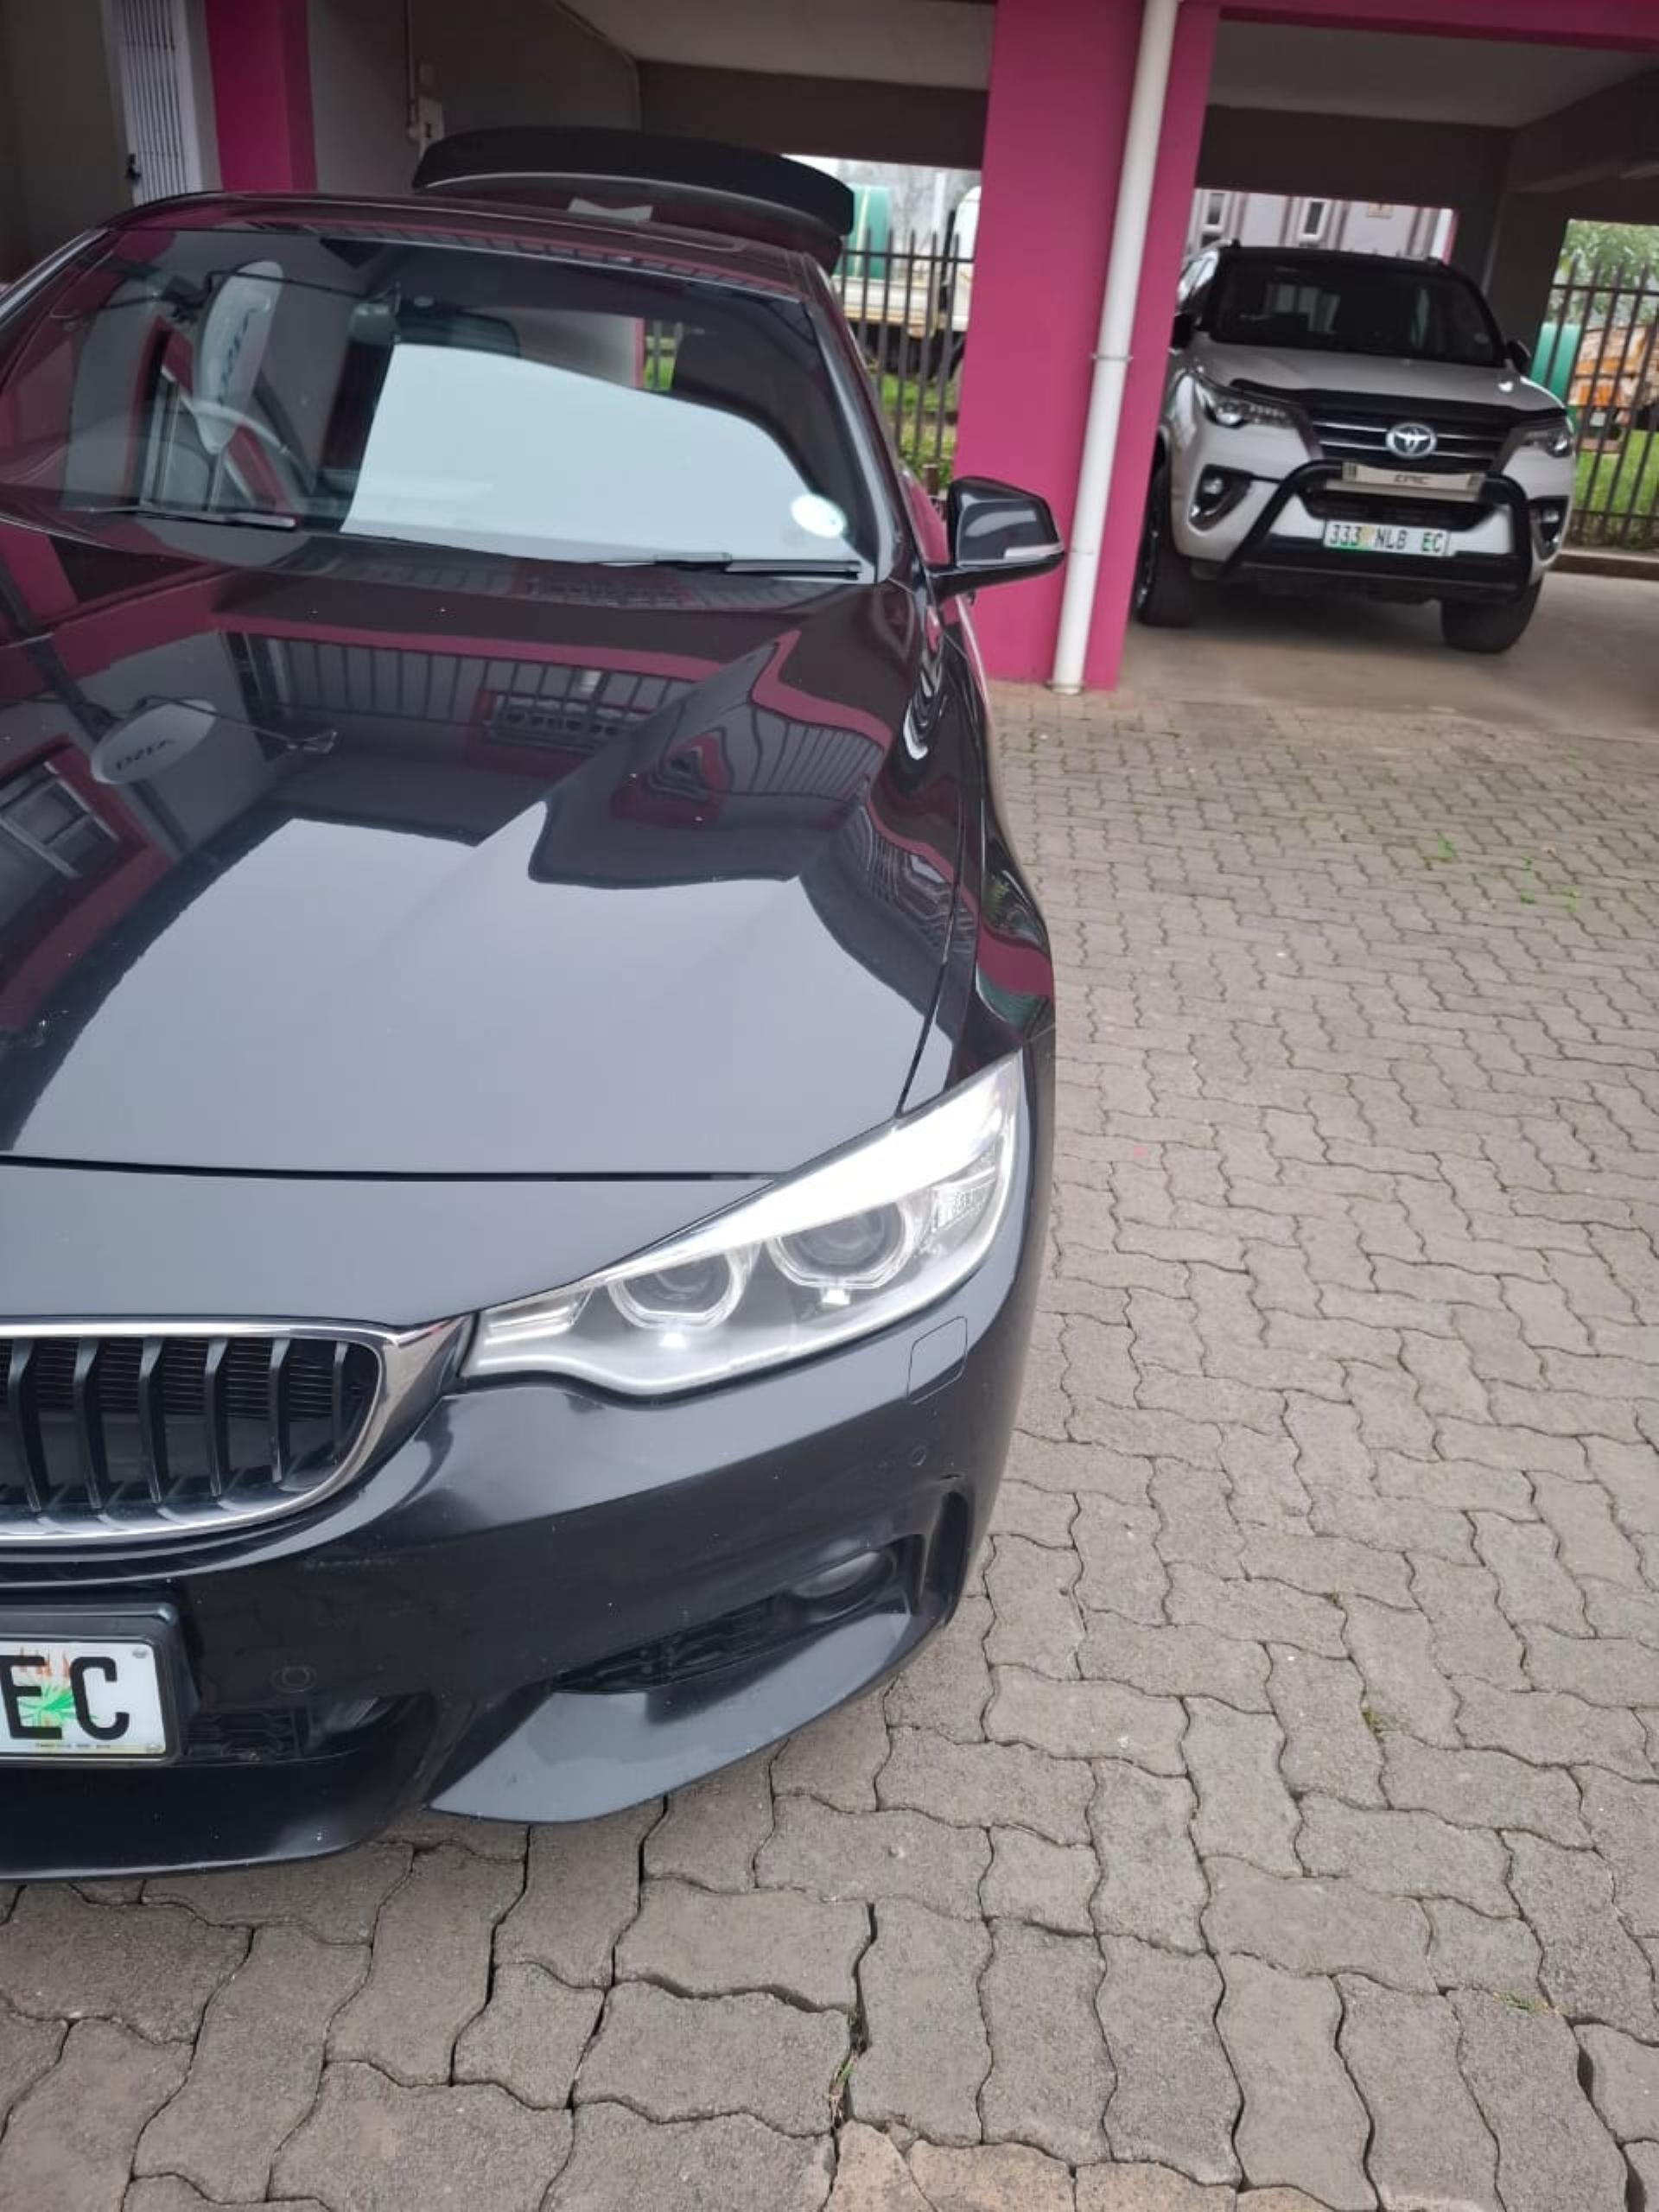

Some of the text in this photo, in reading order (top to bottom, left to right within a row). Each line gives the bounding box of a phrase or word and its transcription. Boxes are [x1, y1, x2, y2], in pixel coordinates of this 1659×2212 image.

[1330, 524, 1363, 546] 333
[1421, 532, 1443, 552] EC
[0, 1655, 130, 1739] EC
